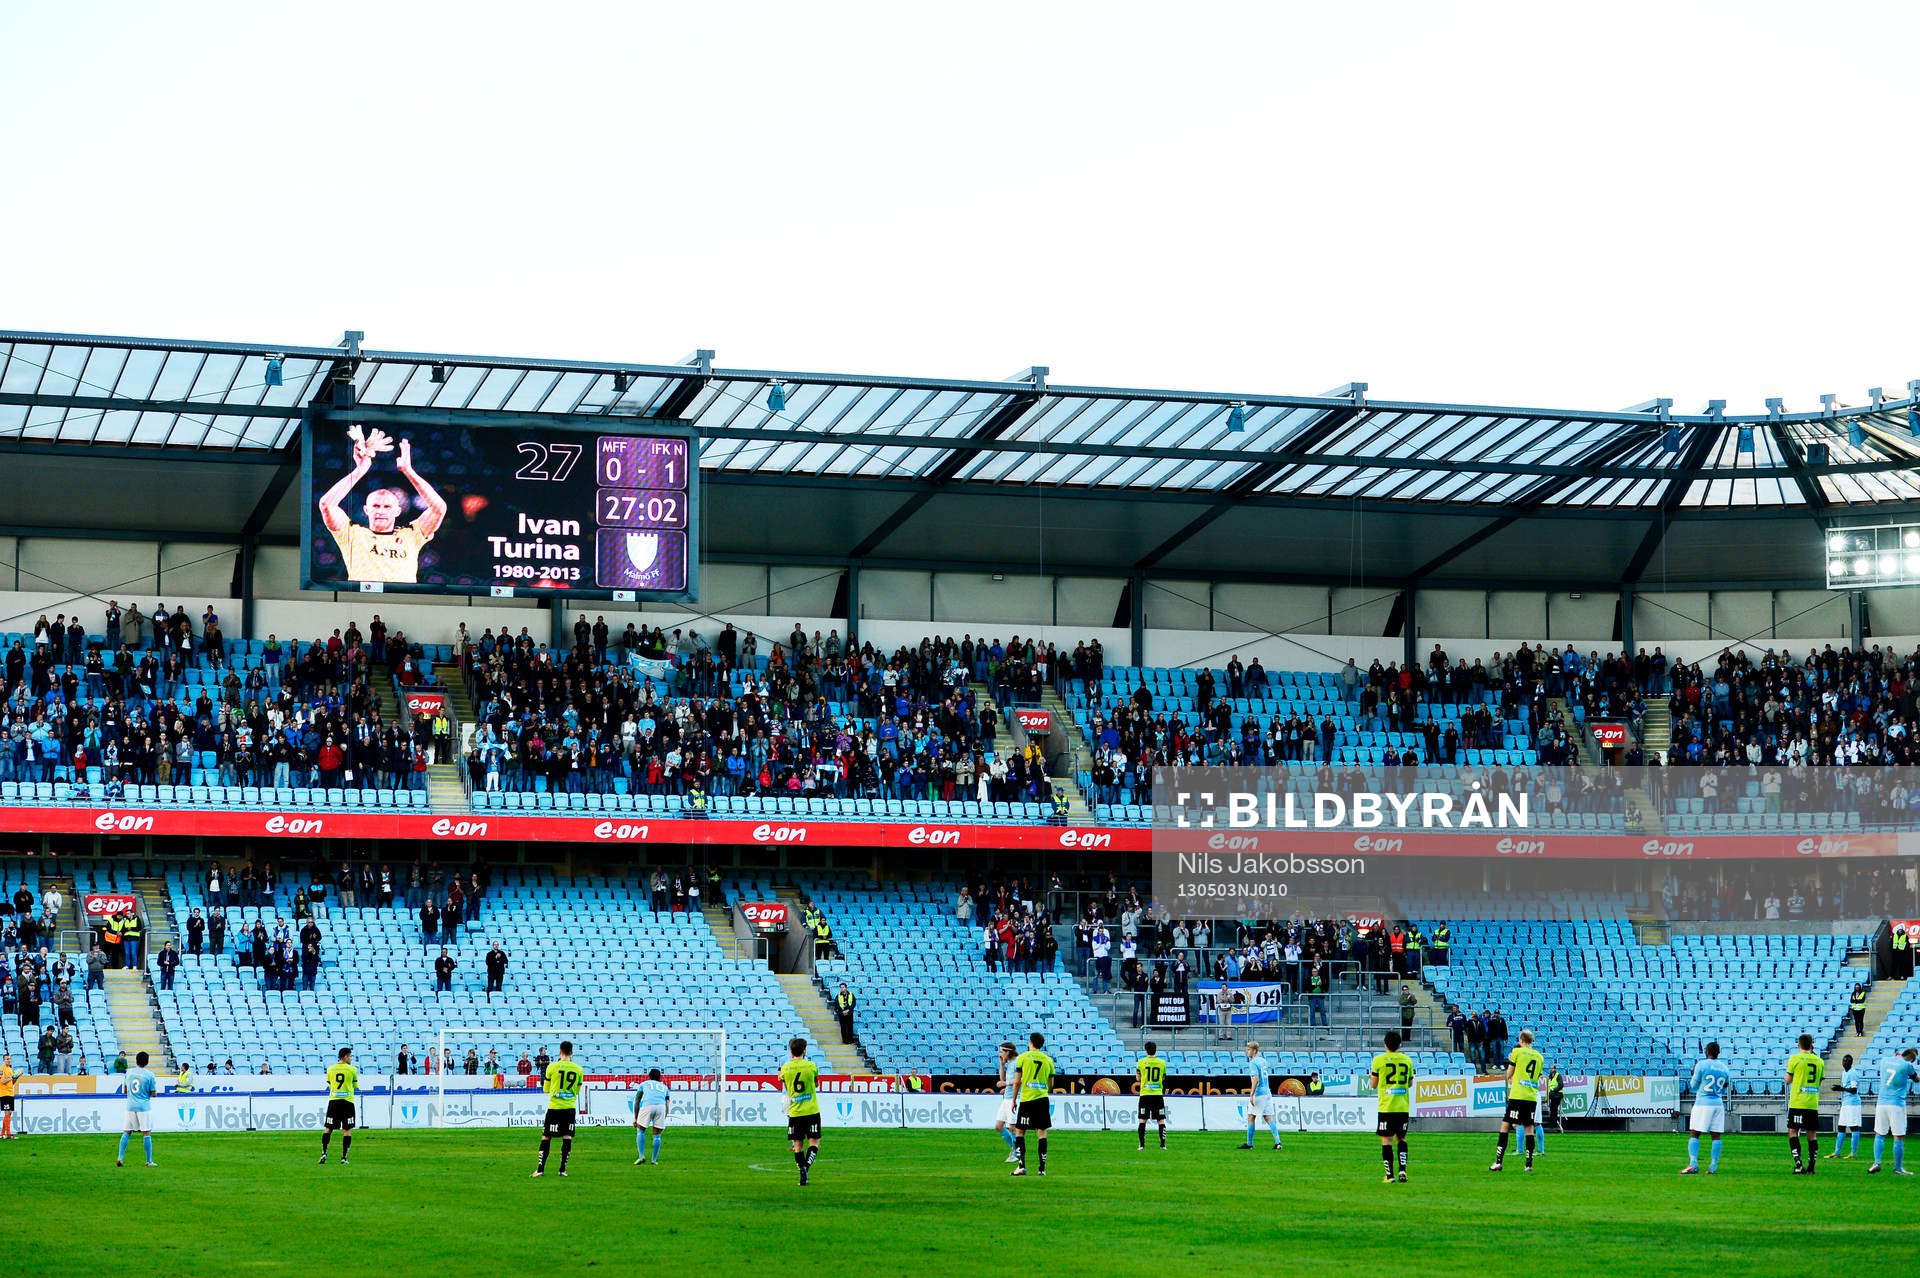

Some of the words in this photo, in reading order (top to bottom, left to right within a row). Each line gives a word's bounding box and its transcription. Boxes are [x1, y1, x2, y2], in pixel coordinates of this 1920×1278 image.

[602, 442, 627, 453] MFF
[651, 443, 670, 455] IFK
[674, 444, 683, 456] N
[516, 442, 582, 481] 27
[606, 458, 621, 481] 0
[664, 461, 675, 483] 1
[605, 496, 678, 522] 27:02
[518, 513, 580, 536] Ivan
[488, 536, 580, 561] Turina
[493, 564, 580, 580] 1980-2013
[1028, 1060, 1042, 1080] 7
[1145, 1066, 1160, 1082] 10
[1386, 1063, 1408, 1085] 23
[1525, 1061, 1535, 1080] 4
[1807, 1063, 1817, 1083] 3
[1886, 1069, 1896, 1086] 7
[131, 1079, 140, 1093] 3
[336, 1073, 345, 1090] 9
[558, 1070, 577, 1091] 19
[793, 1072, 803, 1093] 6
[1419, 1080, 1464, 1097] MALMÖ
[1703, 1075, 1726, 1092] 29
[861, 1100, 973, 1124] Nätverket
[1601, 1106, 1674, 1115] malmotown.com
